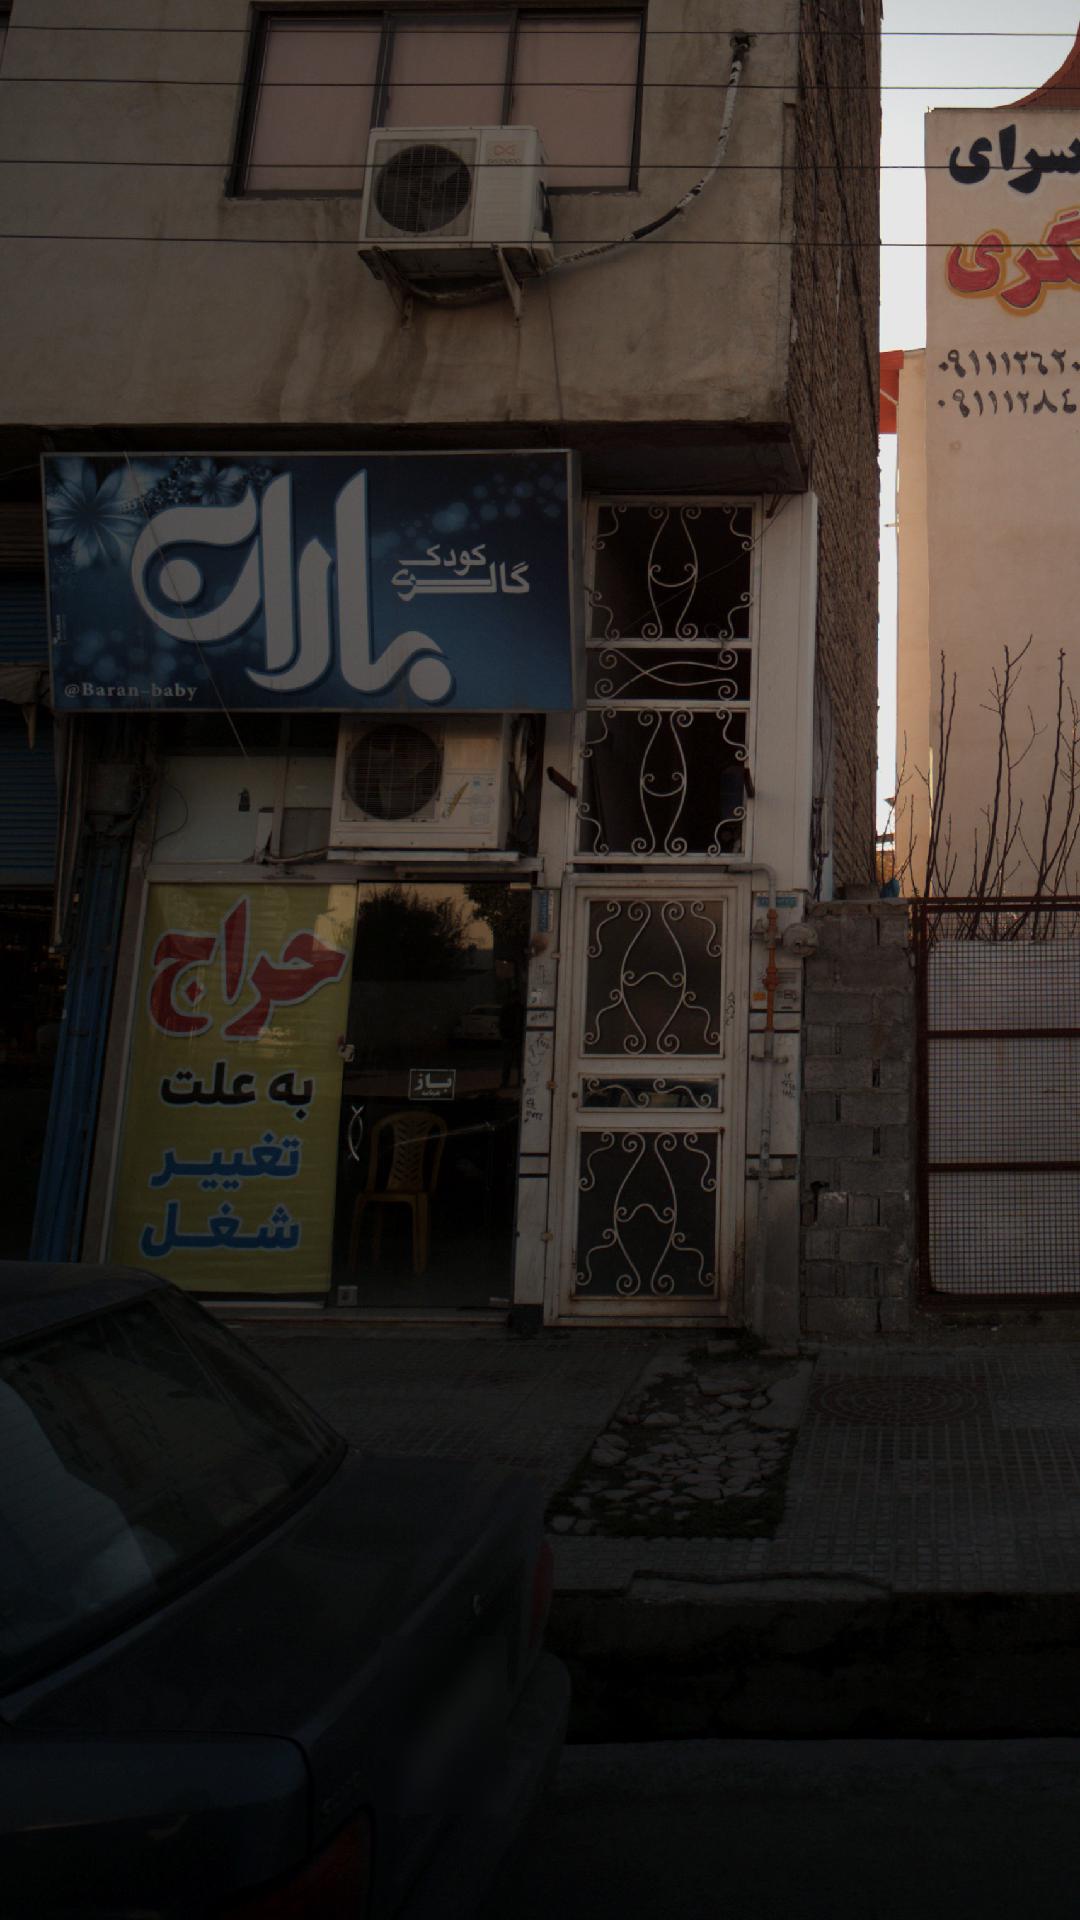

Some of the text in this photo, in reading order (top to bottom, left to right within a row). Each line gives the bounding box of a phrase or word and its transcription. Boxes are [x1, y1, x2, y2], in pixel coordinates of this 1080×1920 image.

[132, 468, 453, 702] باران
[391, 560, 530, 602] گالری
[398, 543, 487, 576] کودک
[148, 897, 347, 1039] حراج
[160, 1061, 315, 1120] به علت
[414, 1072, 452, 1093] باز
[149, 1131, 301, 1190] تغییر
[140, 1201, 300, 1257] شغل
